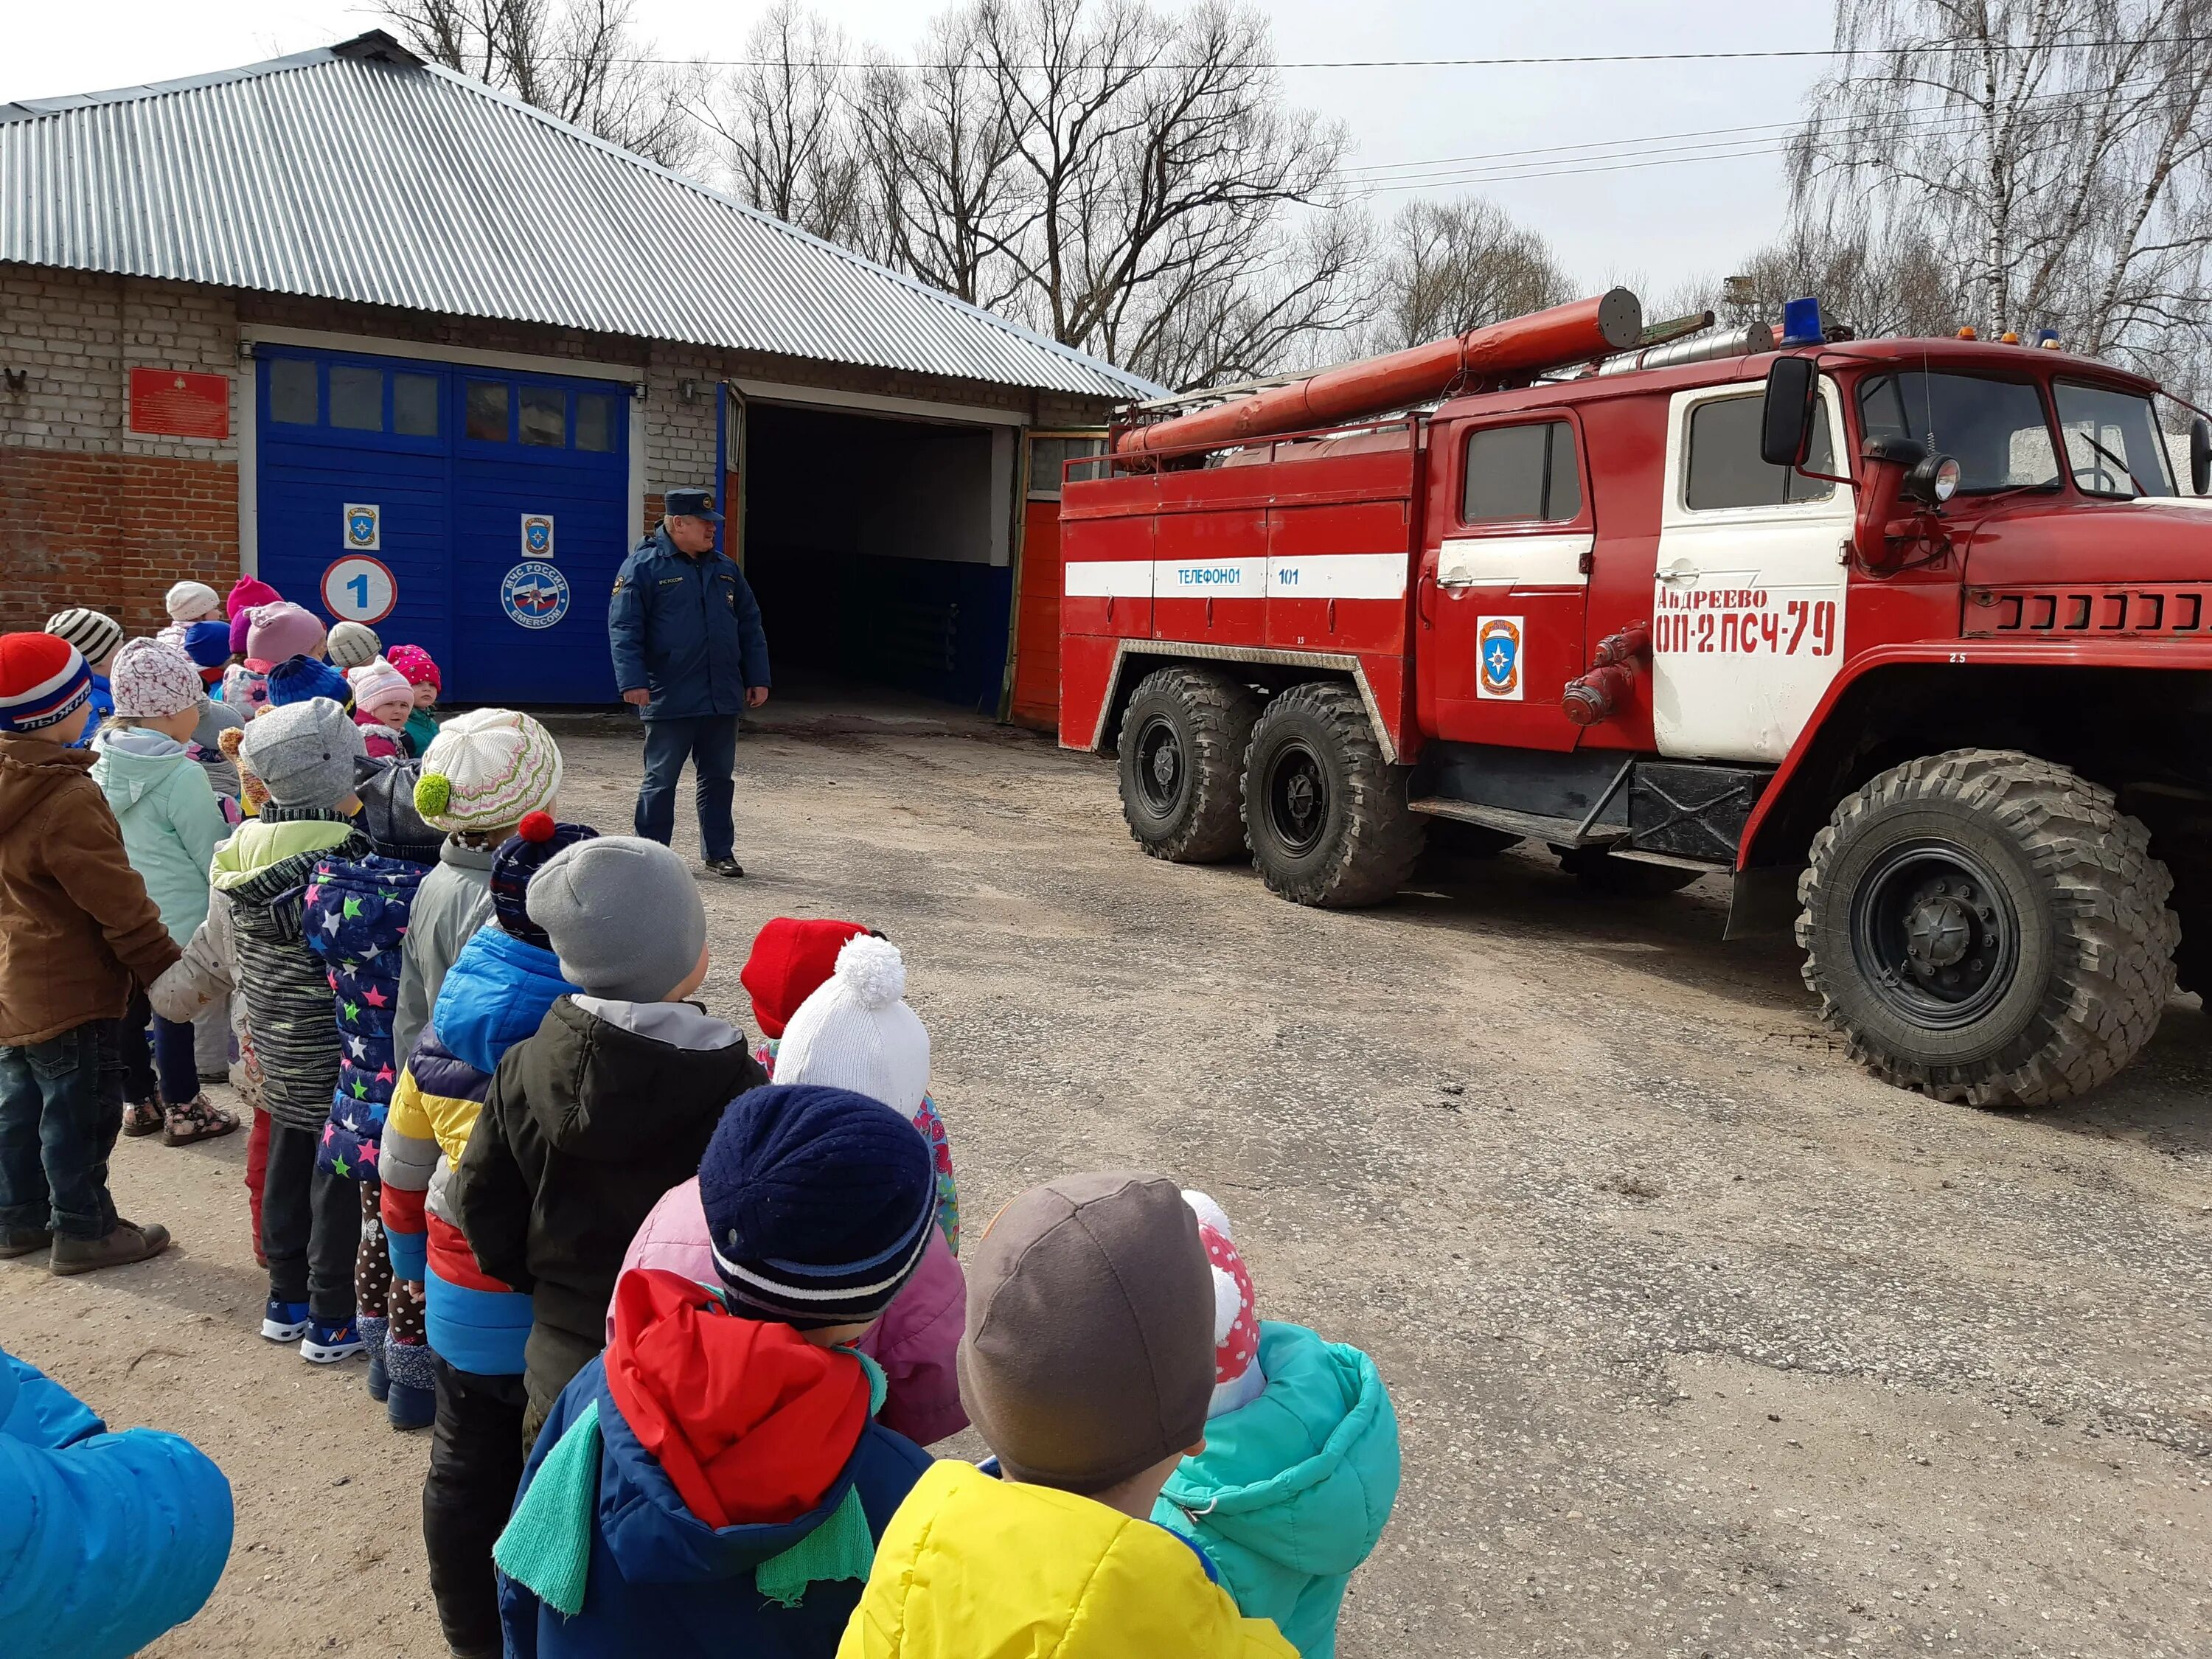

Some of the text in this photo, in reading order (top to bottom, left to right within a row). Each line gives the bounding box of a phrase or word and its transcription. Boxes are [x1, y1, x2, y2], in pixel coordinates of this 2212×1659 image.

[505, 565, 566, 591] МЧС РОССИИ
[1178, 568, 1240, 584] ТЕЛЕФОН 01
[1279, 568, 1298, 585] 101
[347, 574, 368, 608] 1
[511, 608, 562, 626] EMERCOM
[1656, 601, 1836, 656] ОП-2 ПСЧ-79
[1950, 653, 1967, 663] 2.5
[21, 684, 92, 731] ЛЫЖНЯ
